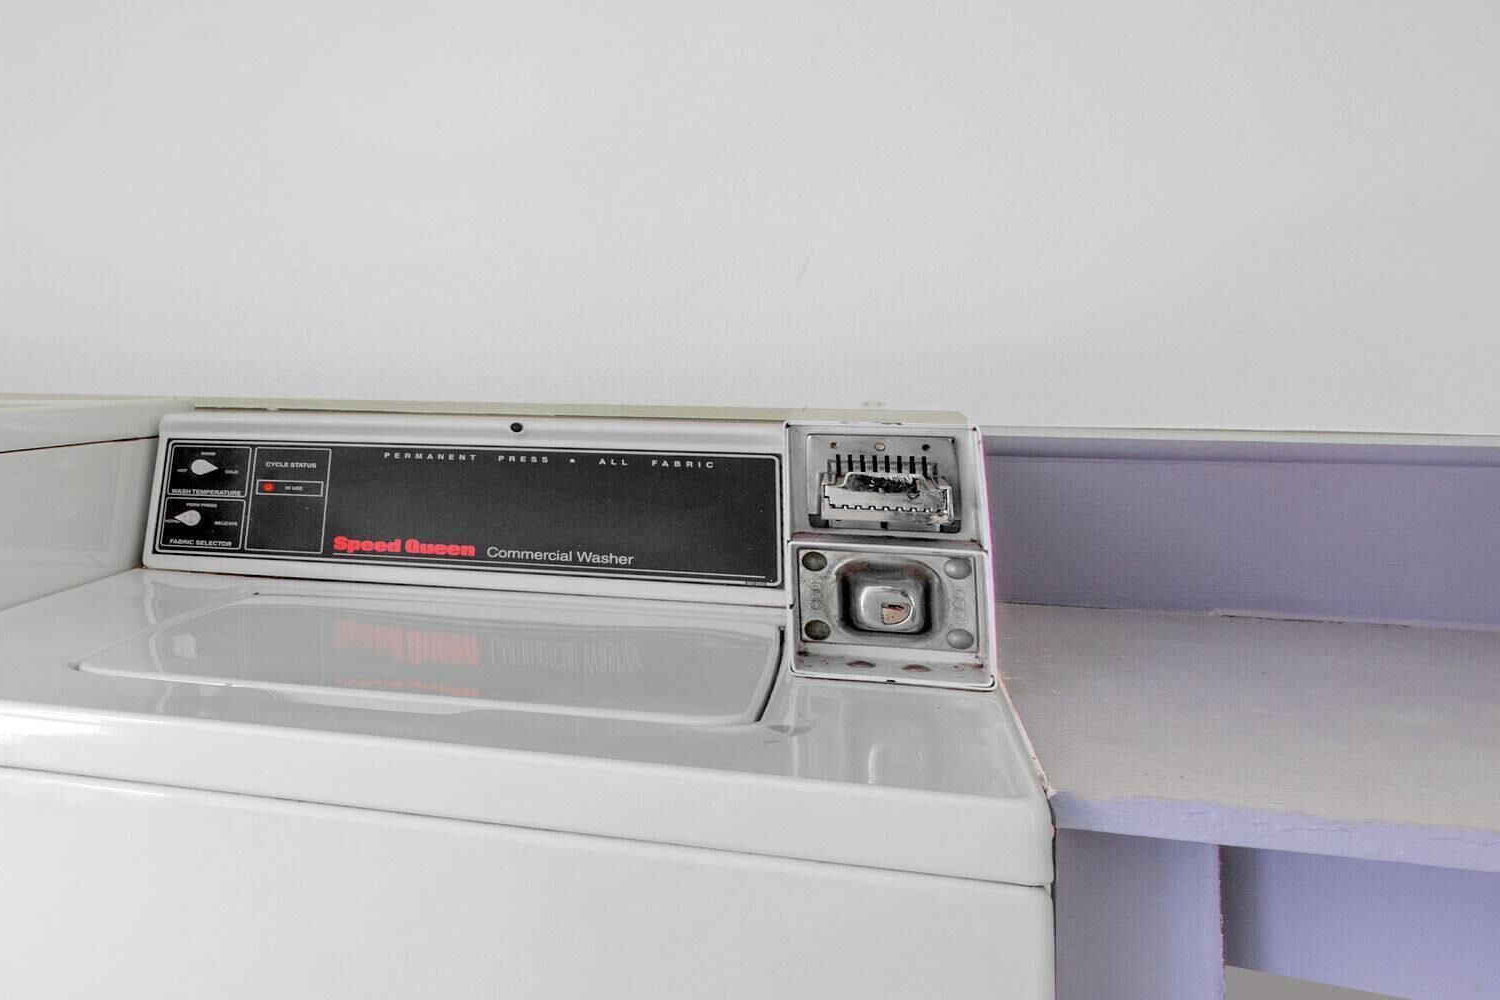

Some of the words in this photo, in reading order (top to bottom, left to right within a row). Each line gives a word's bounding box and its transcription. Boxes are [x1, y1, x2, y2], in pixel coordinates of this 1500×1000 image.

[384, 452, 476, 461] PERMANENT
[498, 455, 549, 464] PRESS
[598, 458, 628, 466] ALL
[652, 460, 714, 468] FABRIC
[333, 535, 402, 554] Speed
[404, 538, 476, 557] Queen
[486, 546, 572, 562] Commercial
[576, 552, 634, 566] Washer
